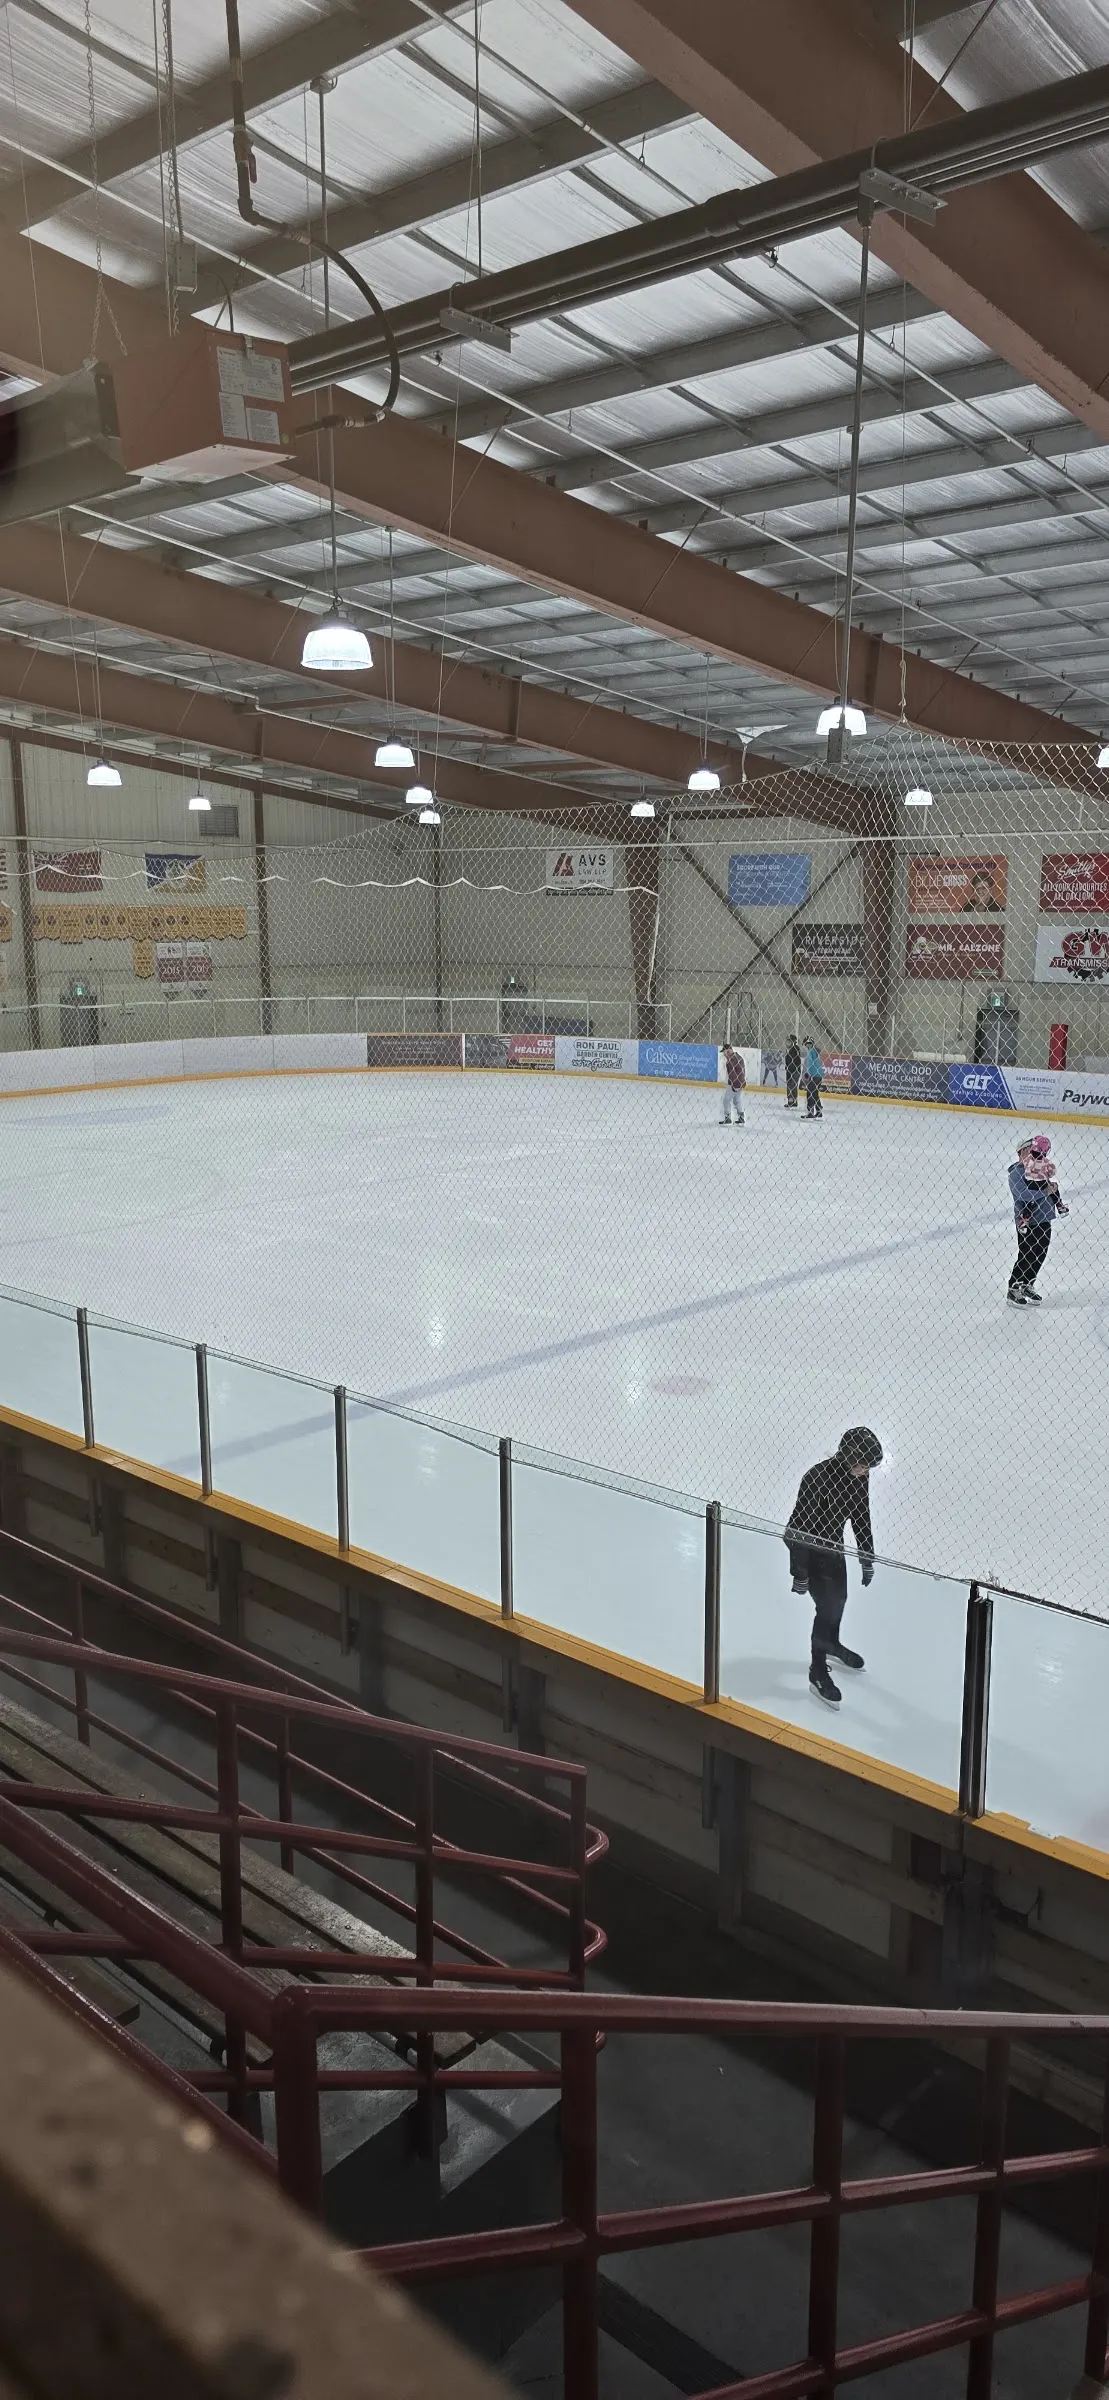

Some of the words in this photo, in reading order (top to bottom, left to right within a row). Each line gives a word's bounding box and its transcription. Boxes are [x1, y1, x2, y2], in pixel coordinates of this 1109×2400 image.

[579, 854, 606, 866] AVS
[805, 935, 865, 946] RIVERSIDE
[960, 944, 1001, 953] CALZONE
[514, 1046, 554, 1055] HEALTHY
[576, 1042, 595, 1050] RON
[598, 1043, 619, 1051] PAUL
[646, 1046, 678, 1065] Caisse
[833, 1059, 851, 1067] GET
[963, 1074, 993, 1091] GLT
